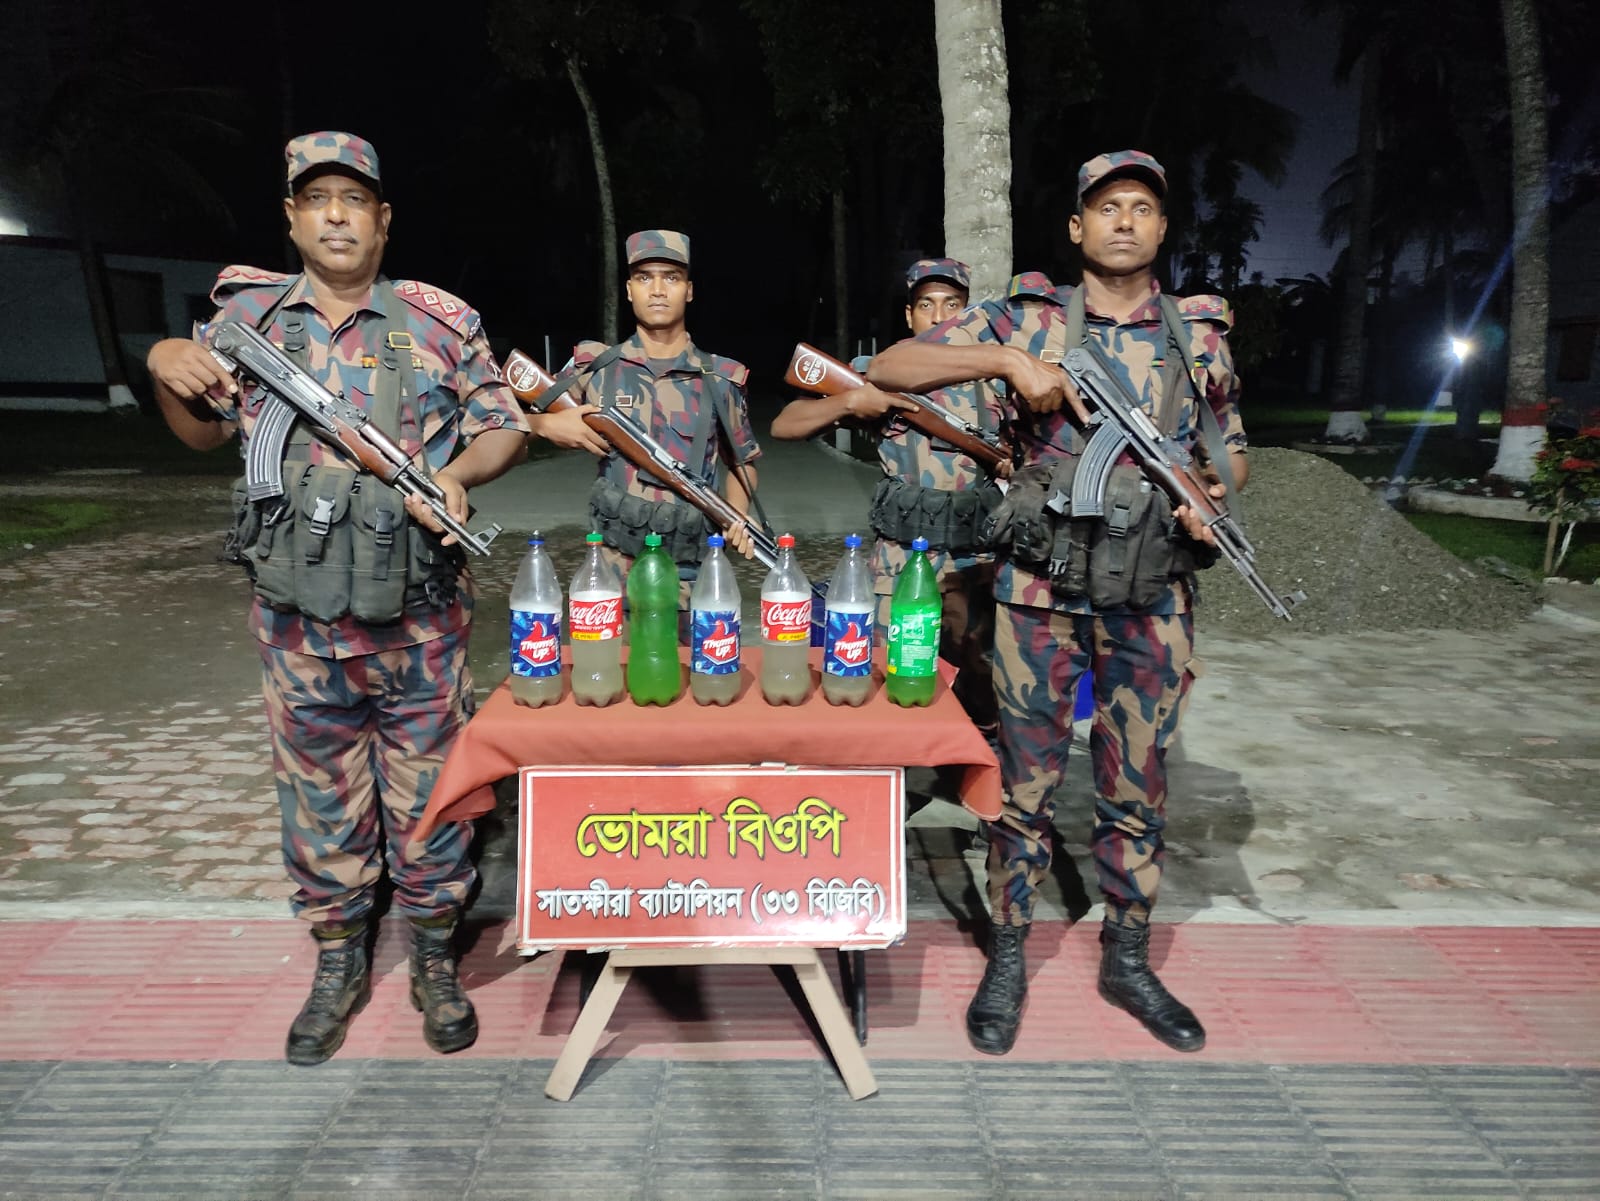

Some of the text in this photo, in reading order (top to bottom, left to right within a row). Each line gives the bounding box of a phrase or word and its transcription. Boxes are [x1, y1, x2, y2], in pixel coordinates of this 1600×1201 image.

[576, 796, 848, 860] ভোমরা বিওপি
[536, 877, 886, 924] সাতক্ষীরা ব্যাটালিয়ন (৩৩ বিজিবি)
